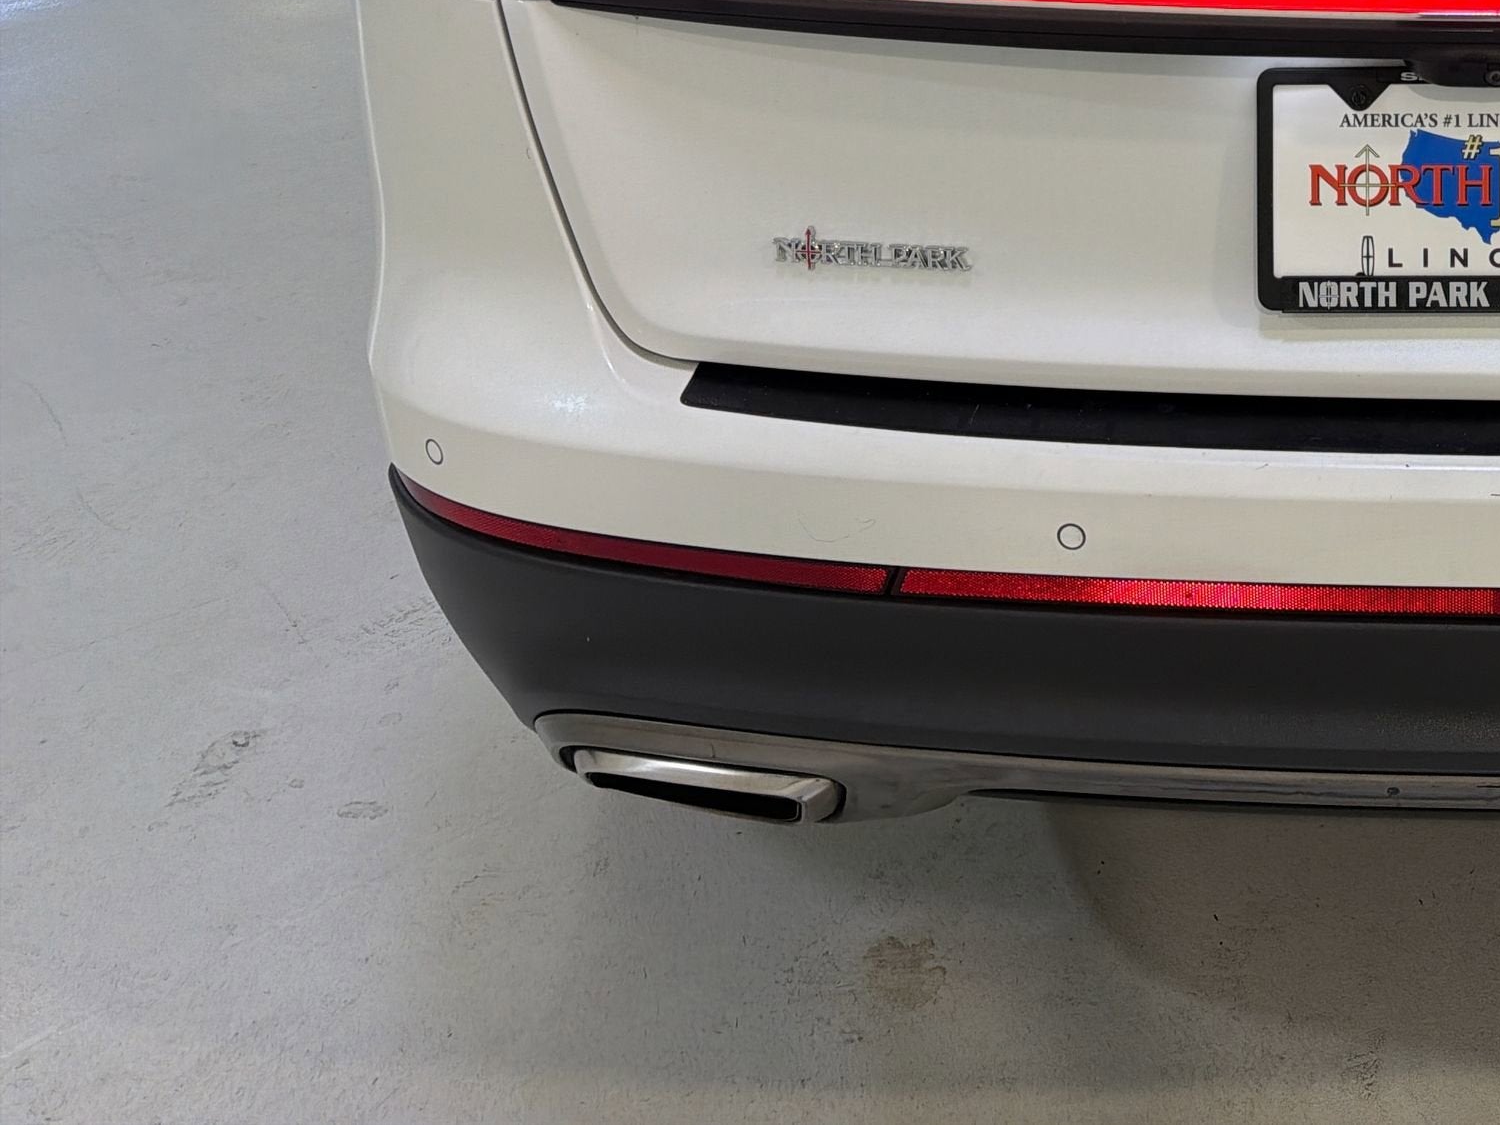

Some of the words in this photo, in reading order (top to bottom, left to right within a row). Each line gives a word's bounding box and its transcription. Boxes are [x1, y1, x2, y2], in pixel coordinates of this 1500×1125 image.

[1339, 113, 1438, 128] AMERICA'S
[1443, 113, 1461, 128] #1
[1307, 163, 1492, 207] NORTH
[773, 237, 882, 267] NORTH
[889, 243, 972, 271] PARK
[1298, 282, 1397, 308] NORTH
[1408, 282, 1491, 308] PARK
